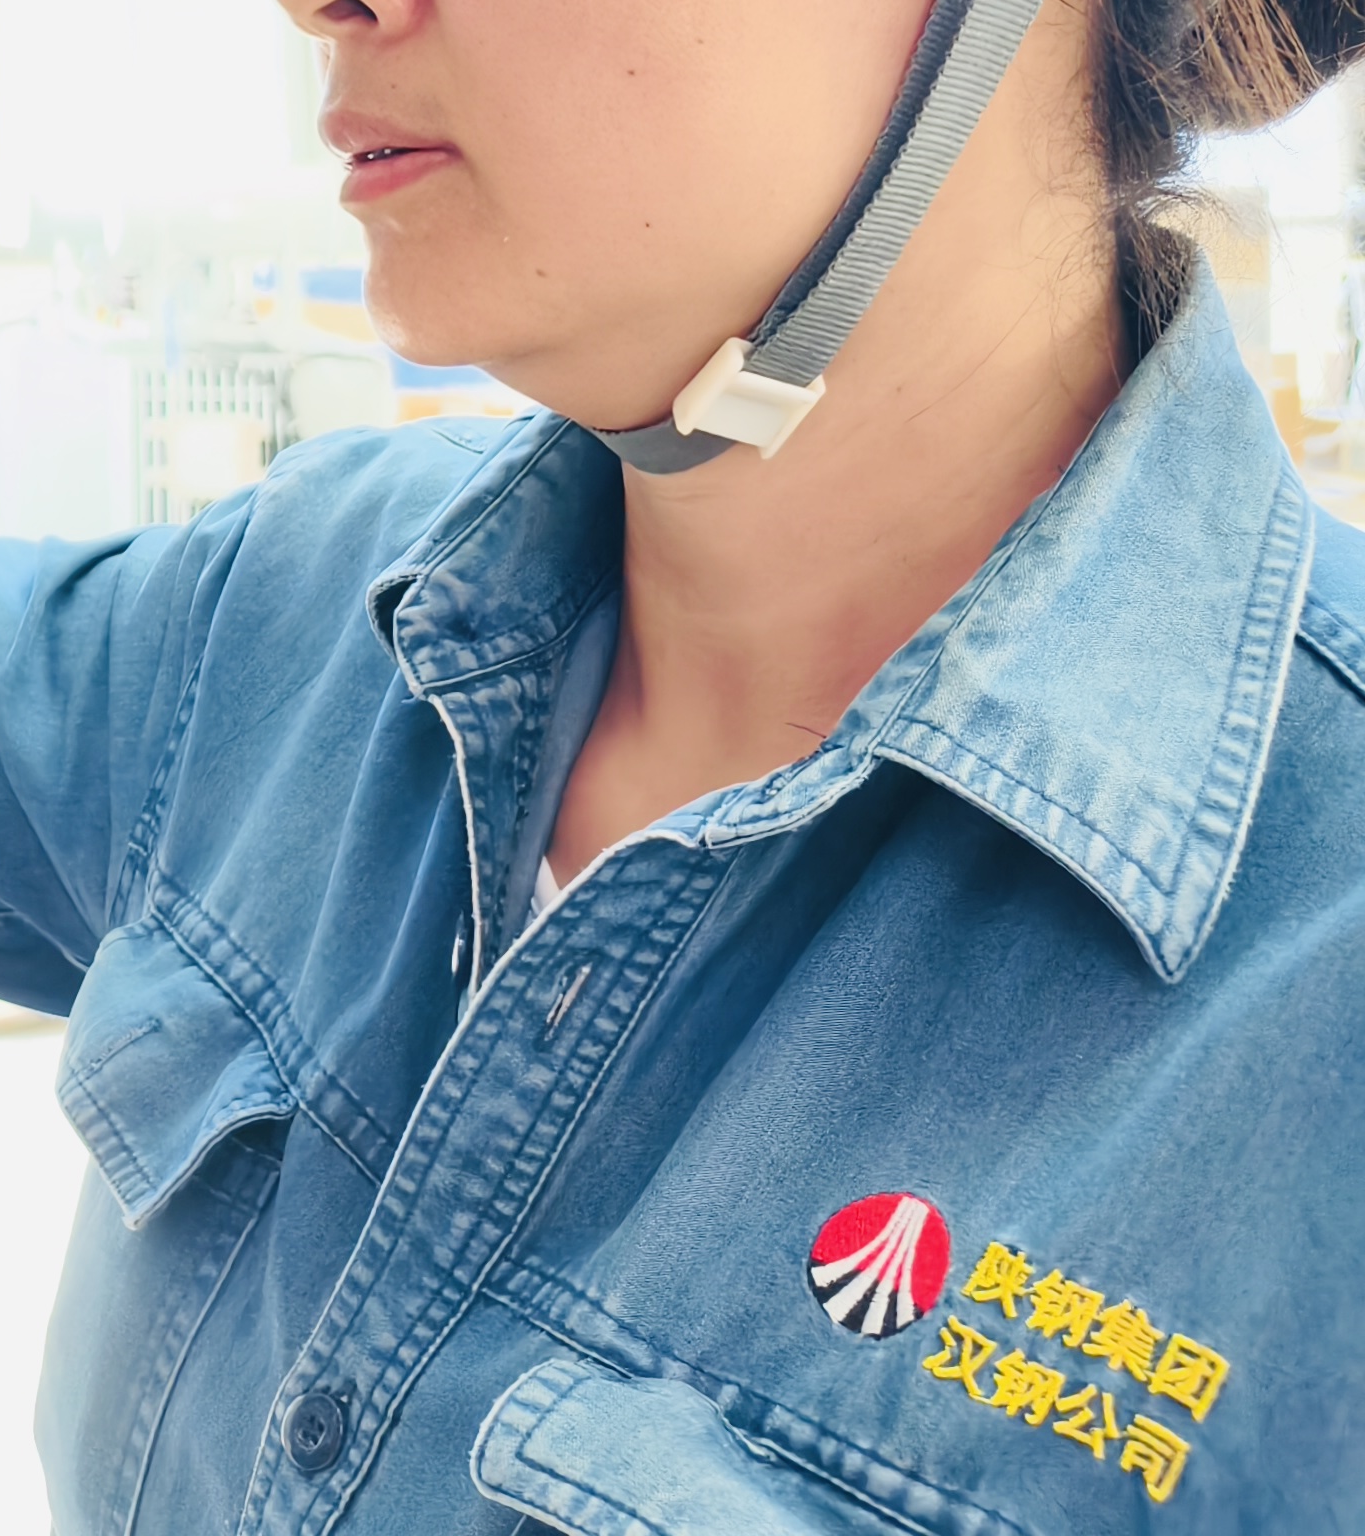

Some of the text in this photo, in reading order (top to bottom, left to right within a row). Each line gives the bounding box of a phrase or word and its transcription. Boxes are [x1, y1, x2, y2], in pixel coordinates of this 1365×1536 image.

[922, 1315, 1191, 1503] 汉钢公司
[961, 1241, 1230, 1423] 陕钢集团
